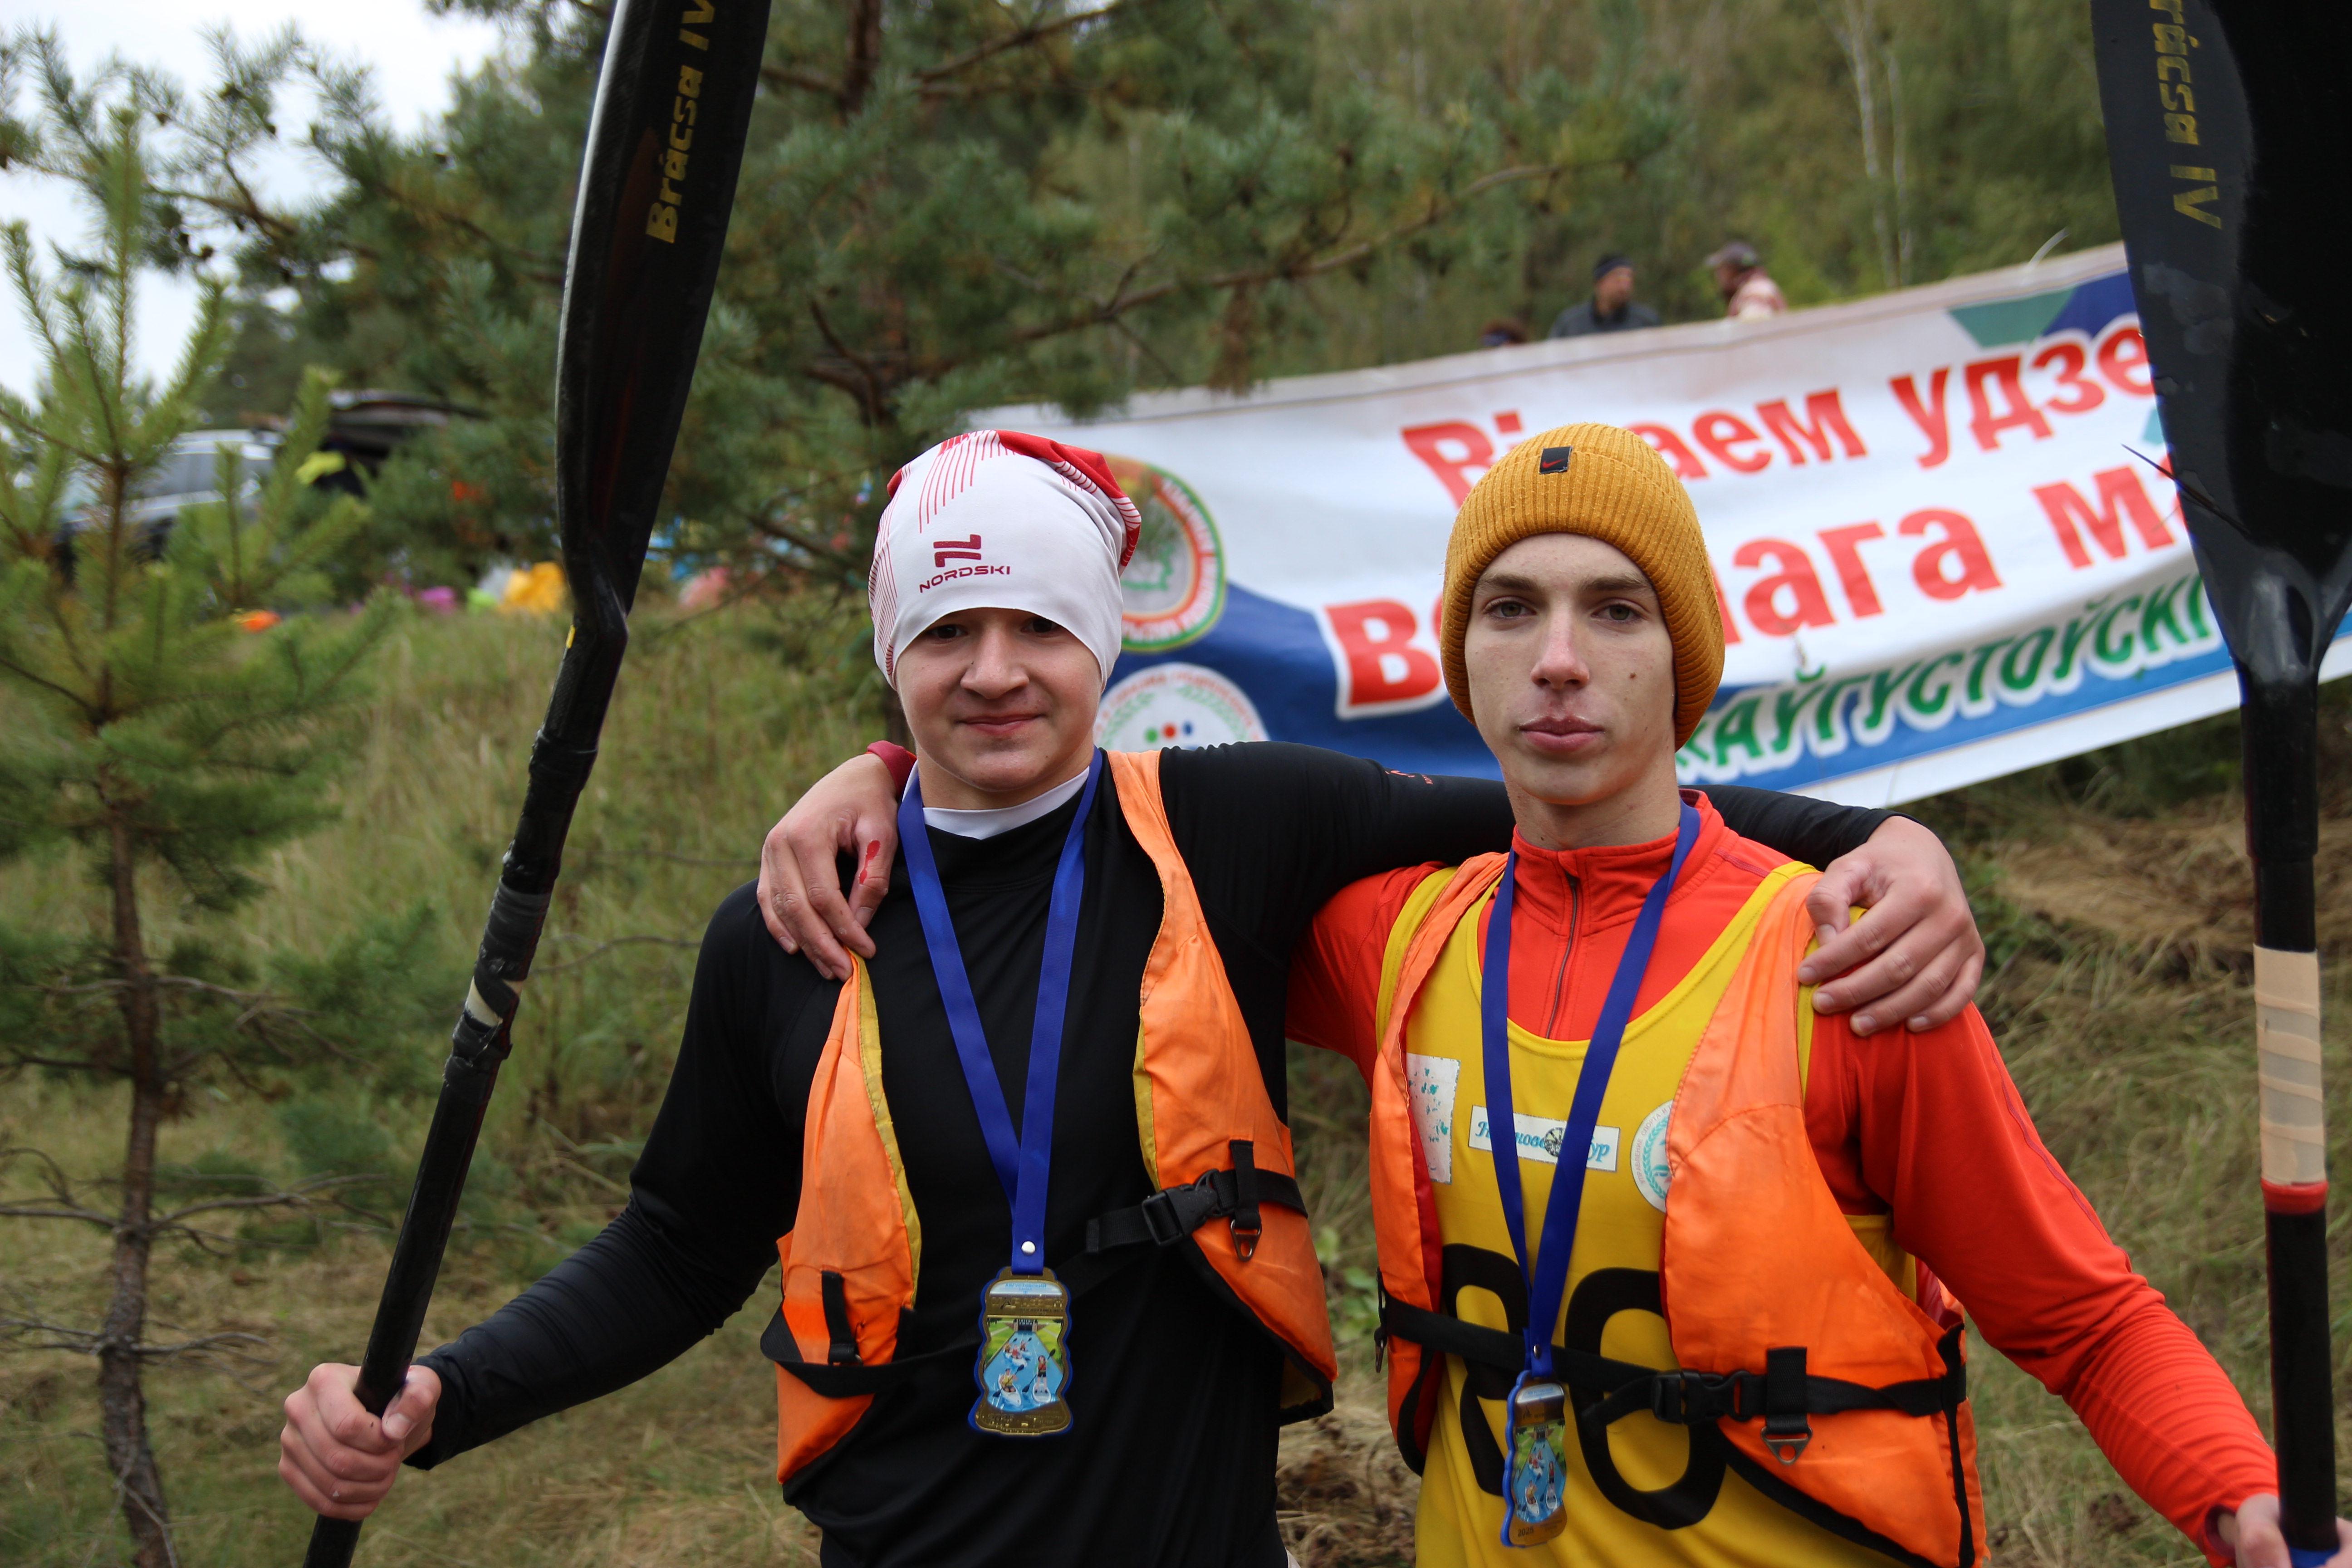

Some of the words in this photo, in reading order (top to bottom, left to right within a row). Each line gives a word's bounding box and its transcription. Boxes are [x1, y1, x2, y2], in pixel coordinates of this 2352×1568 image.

[679, 0, 715, 51] IV
[2149, 0, 2200, 145] rácsa
[2170, 164, 2222, 229] IV
[920, 565, 1010, 593] NORDSKI
[1642, 1113, 1661, 1136] СПОРТА
